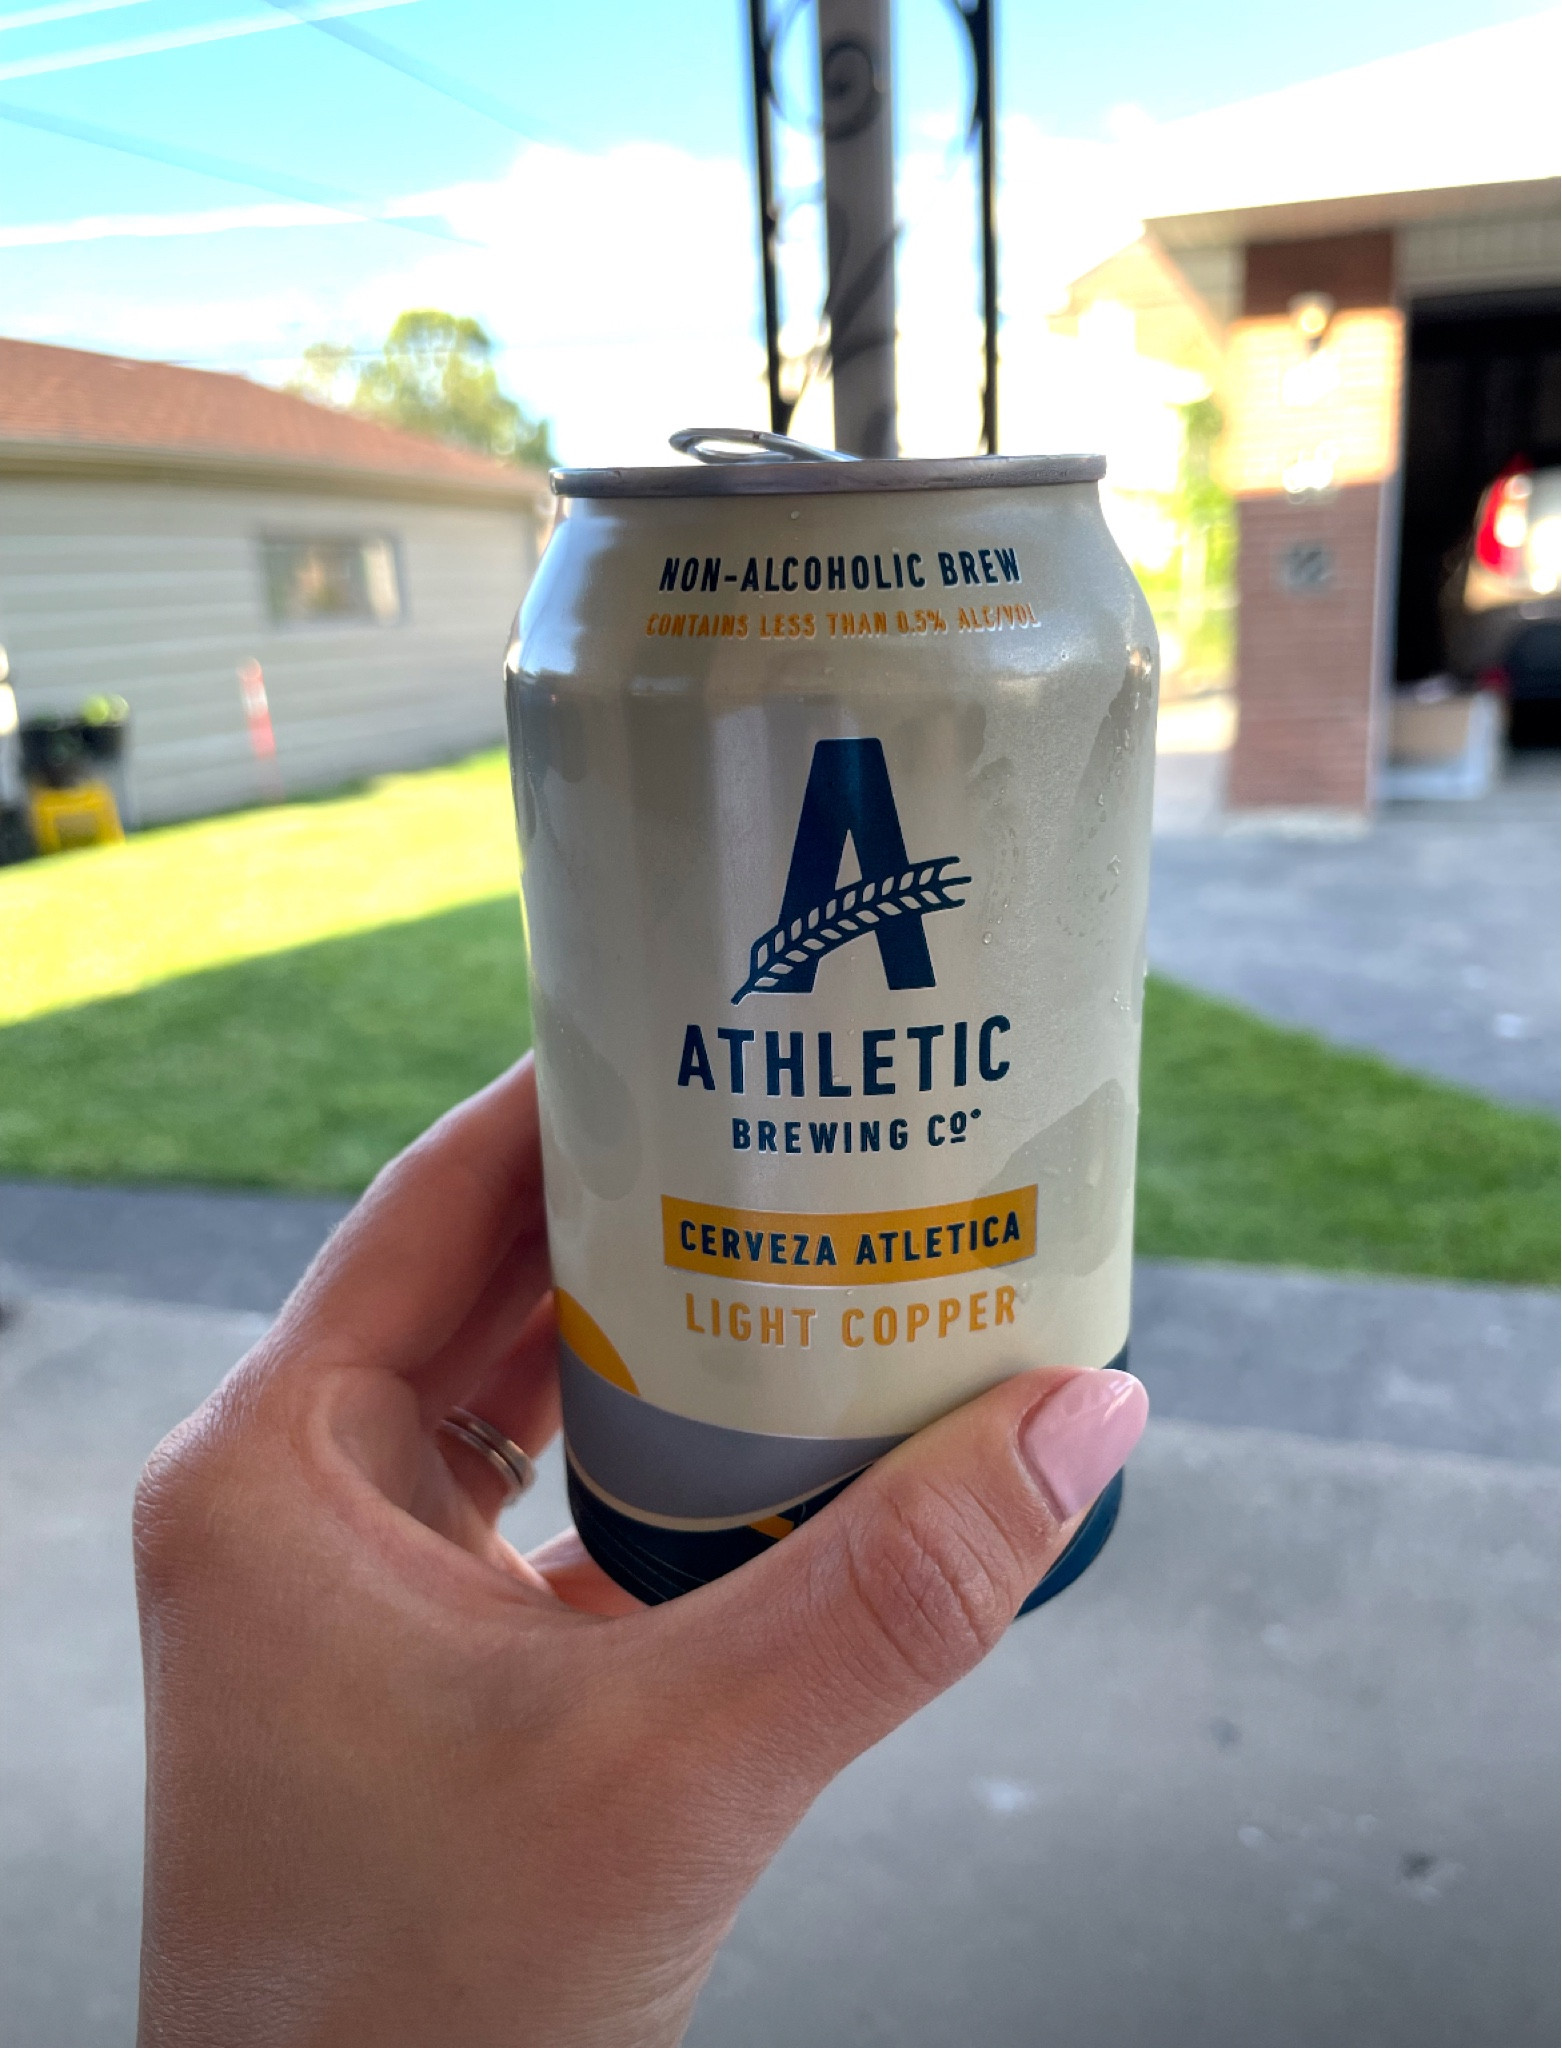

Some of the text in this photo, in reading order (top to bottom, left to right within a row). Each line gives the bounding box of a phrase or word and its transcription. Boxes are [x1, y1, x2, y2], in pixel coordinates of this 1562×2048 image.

[659, 547, 1022, 593] NON-ALCOHOLIC BREW
[646, 602, 1042, 639] CONTAINS LESS THAN 0.5% ALC/VOL
[677, 1014, 1012, 1098] ATHLETIC
[732, 1117, 908, 1154] BREWING
[680, 1211, 1021, 1266] CERVEZA ATLETICA
[685, 1285, 1017, 1349] LIGHT COPPER
